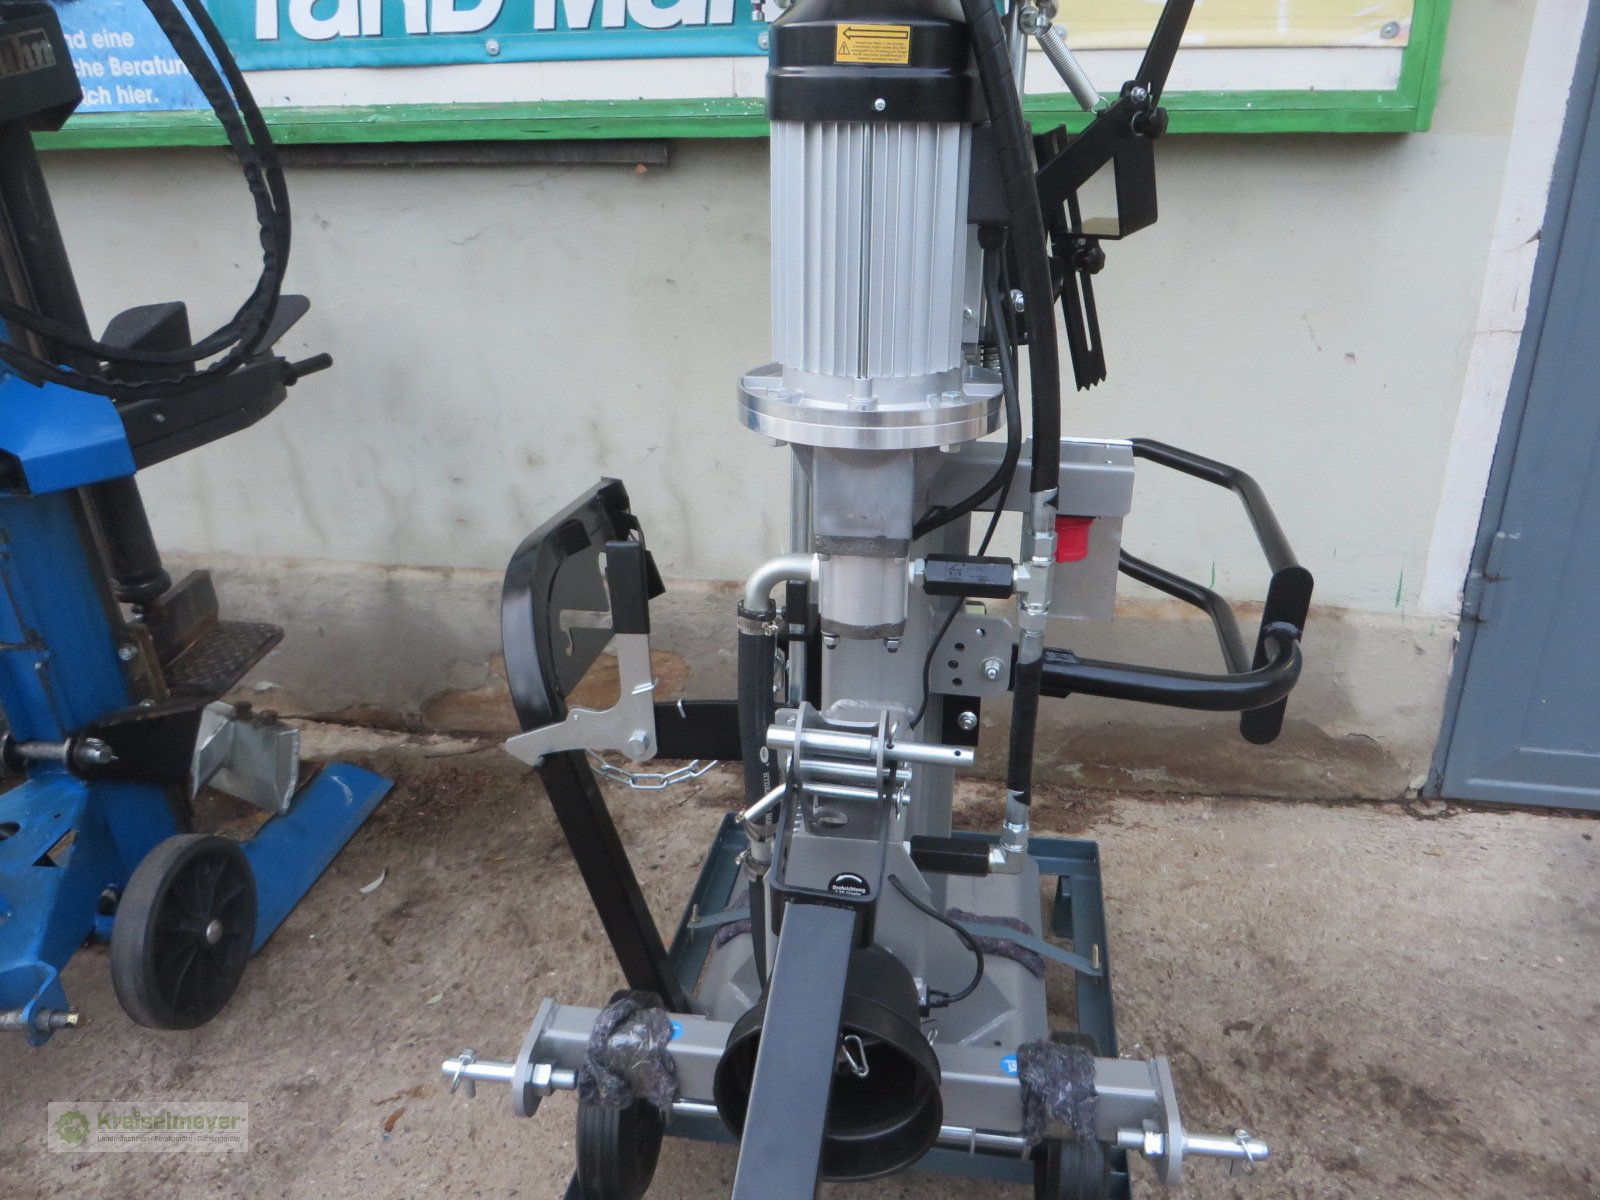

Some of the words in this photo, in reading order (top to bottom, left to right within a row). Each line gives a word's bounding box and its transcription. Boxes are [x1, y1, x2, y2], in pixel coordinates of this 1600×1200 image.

[64, 28, 87, 49] nd
[92, 28, 135, 48] eine
[73, 57, 104, 78] che
[108, 55, 190, 77] Beratun
[81, 85, 112, 105] ich
[115, 85, 160, 105] hier.
